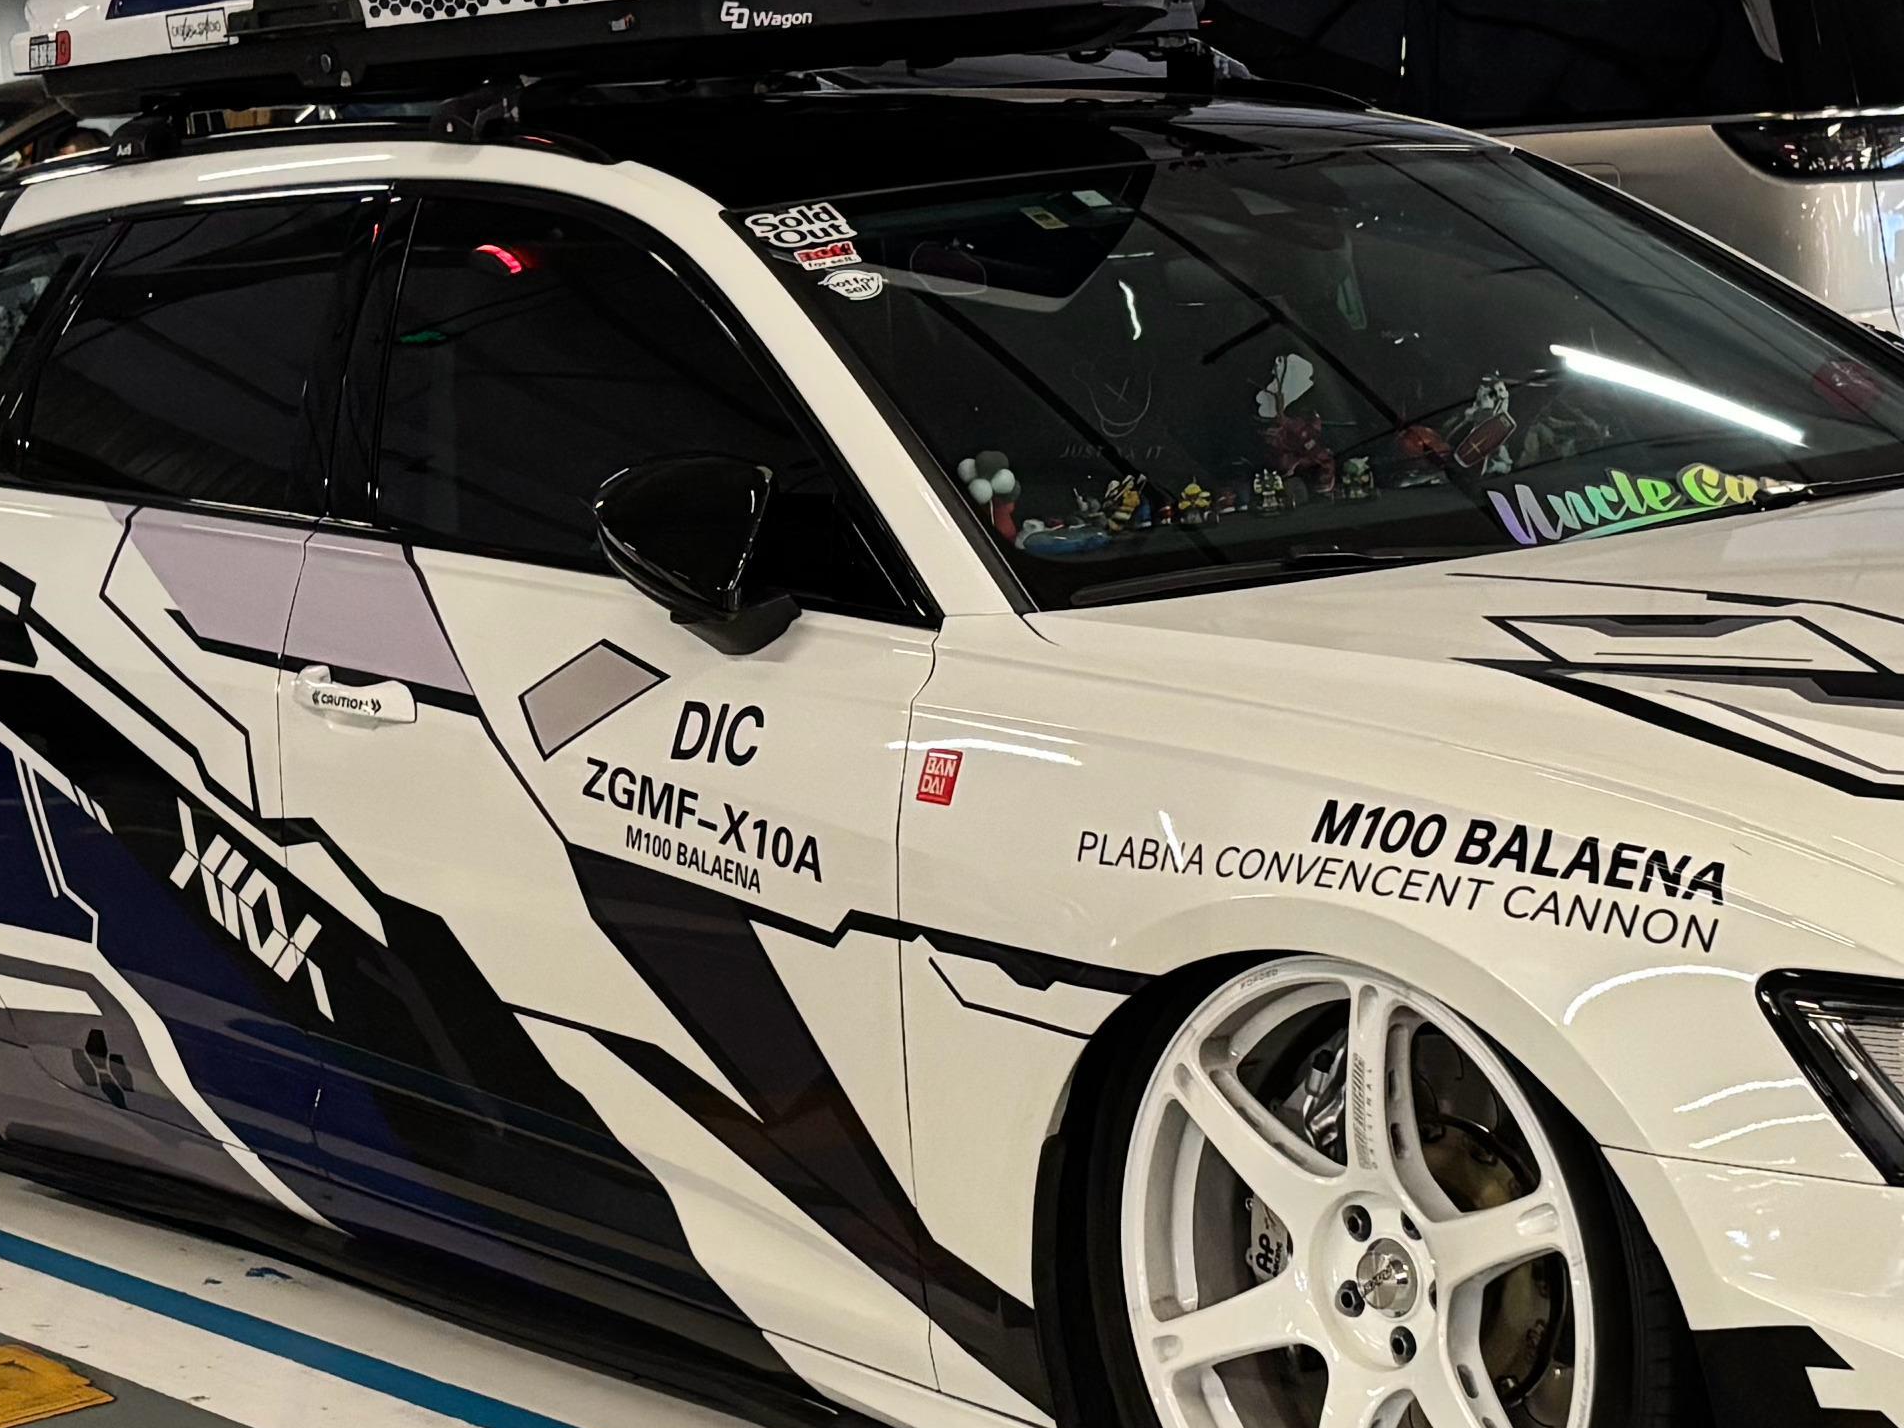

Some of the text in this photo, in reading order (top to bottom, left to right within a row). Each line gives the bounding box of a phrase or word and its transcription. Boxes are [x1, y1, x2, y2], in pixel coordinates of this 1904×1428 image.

[752, 11, 813, 29] Wagon
[750, 204, 840, 234] Sold
[773, 223, 850, 244] Out
[1487, 468, 1681, 545] Uncle
[670, 700, 765, 766] DIC
[626, 824, 761, 894] M100 BALAENA
[1311, 799, 1726, 906] M100 BALAENA
[1215, 845, 1495, 911] CONVENCENT
[1503, 886, 1719, 954] CANNON
